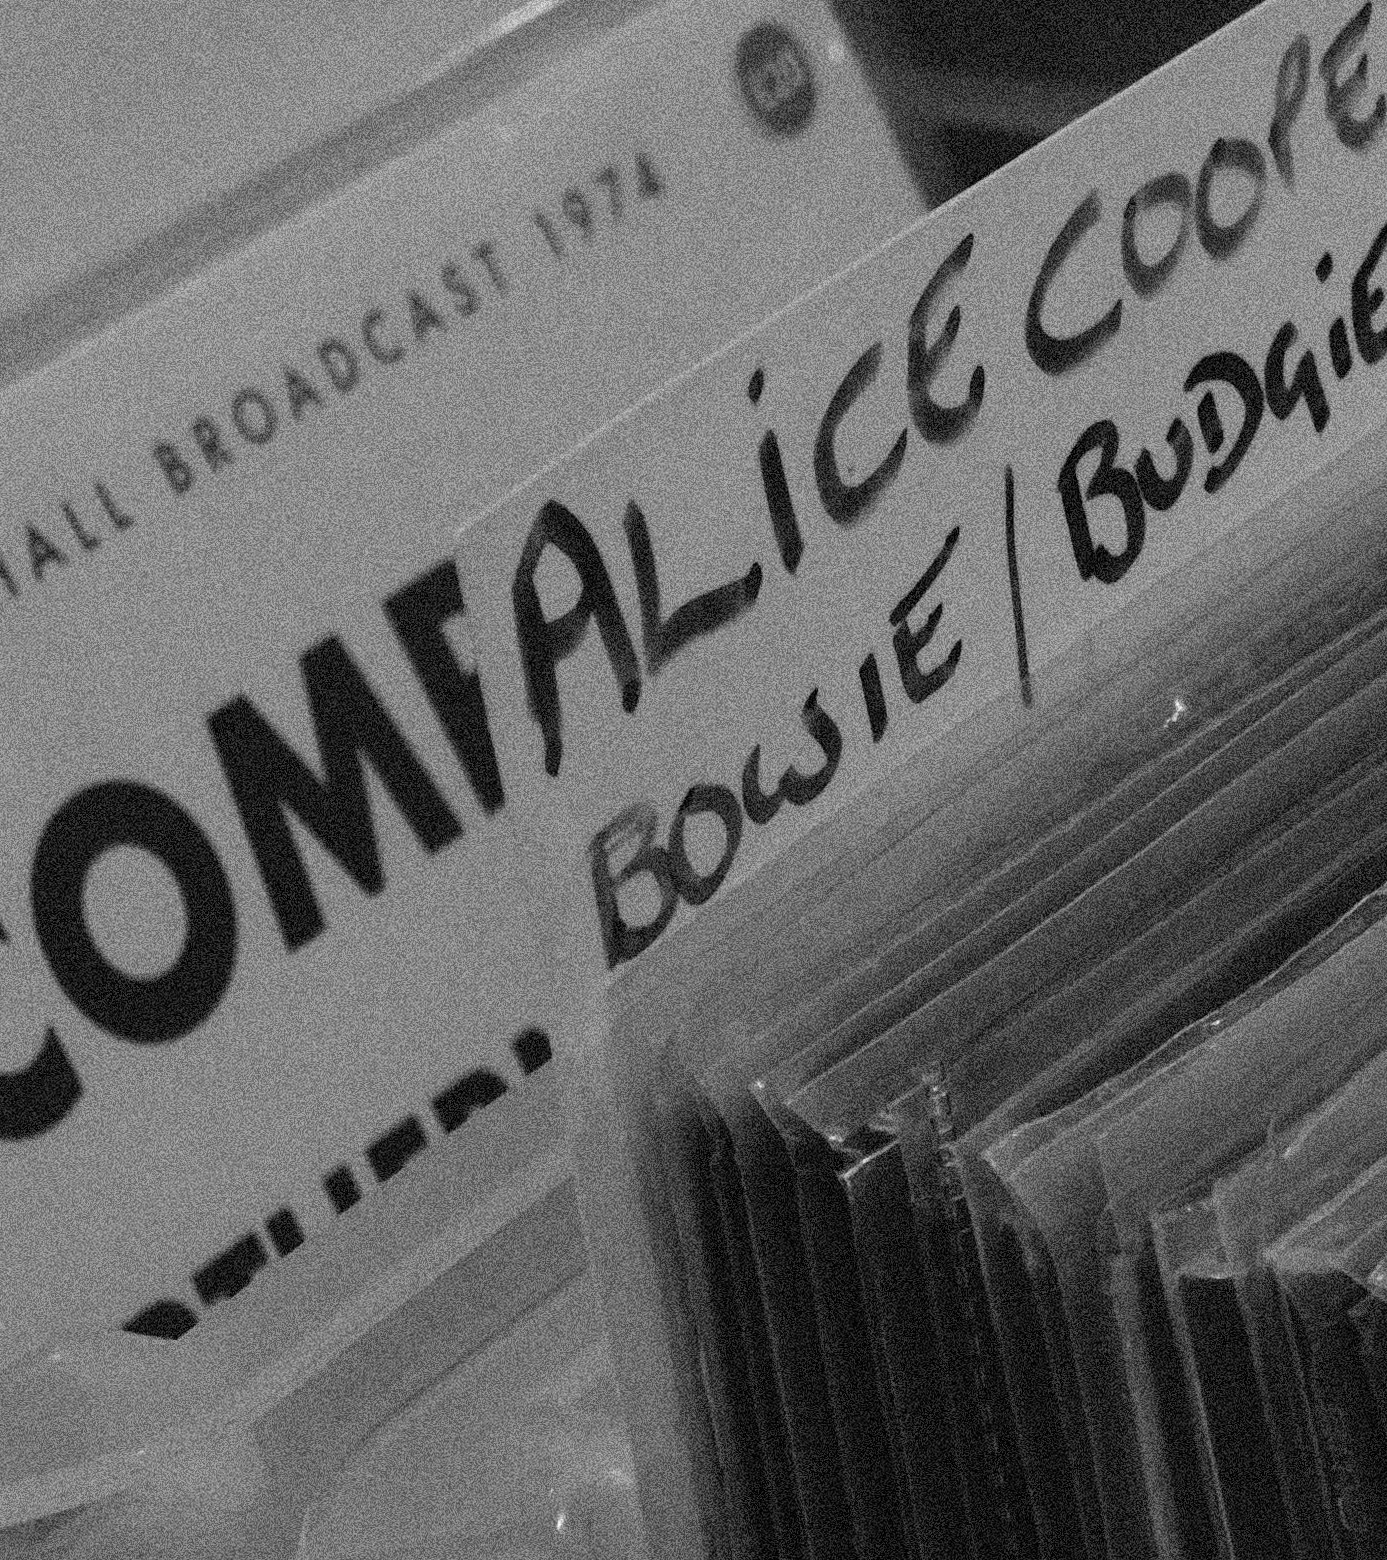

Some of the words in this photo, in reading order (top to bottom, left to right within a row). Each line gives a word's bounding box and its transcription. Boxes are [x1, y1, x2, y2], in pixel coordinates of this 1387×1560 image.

[152, 239, 511, 496] BROADCAST
[532, 147, 667, 260] 1974
[511, 233, 986, 778] ALICE
[590, 523, 964, 970] BOWIE
